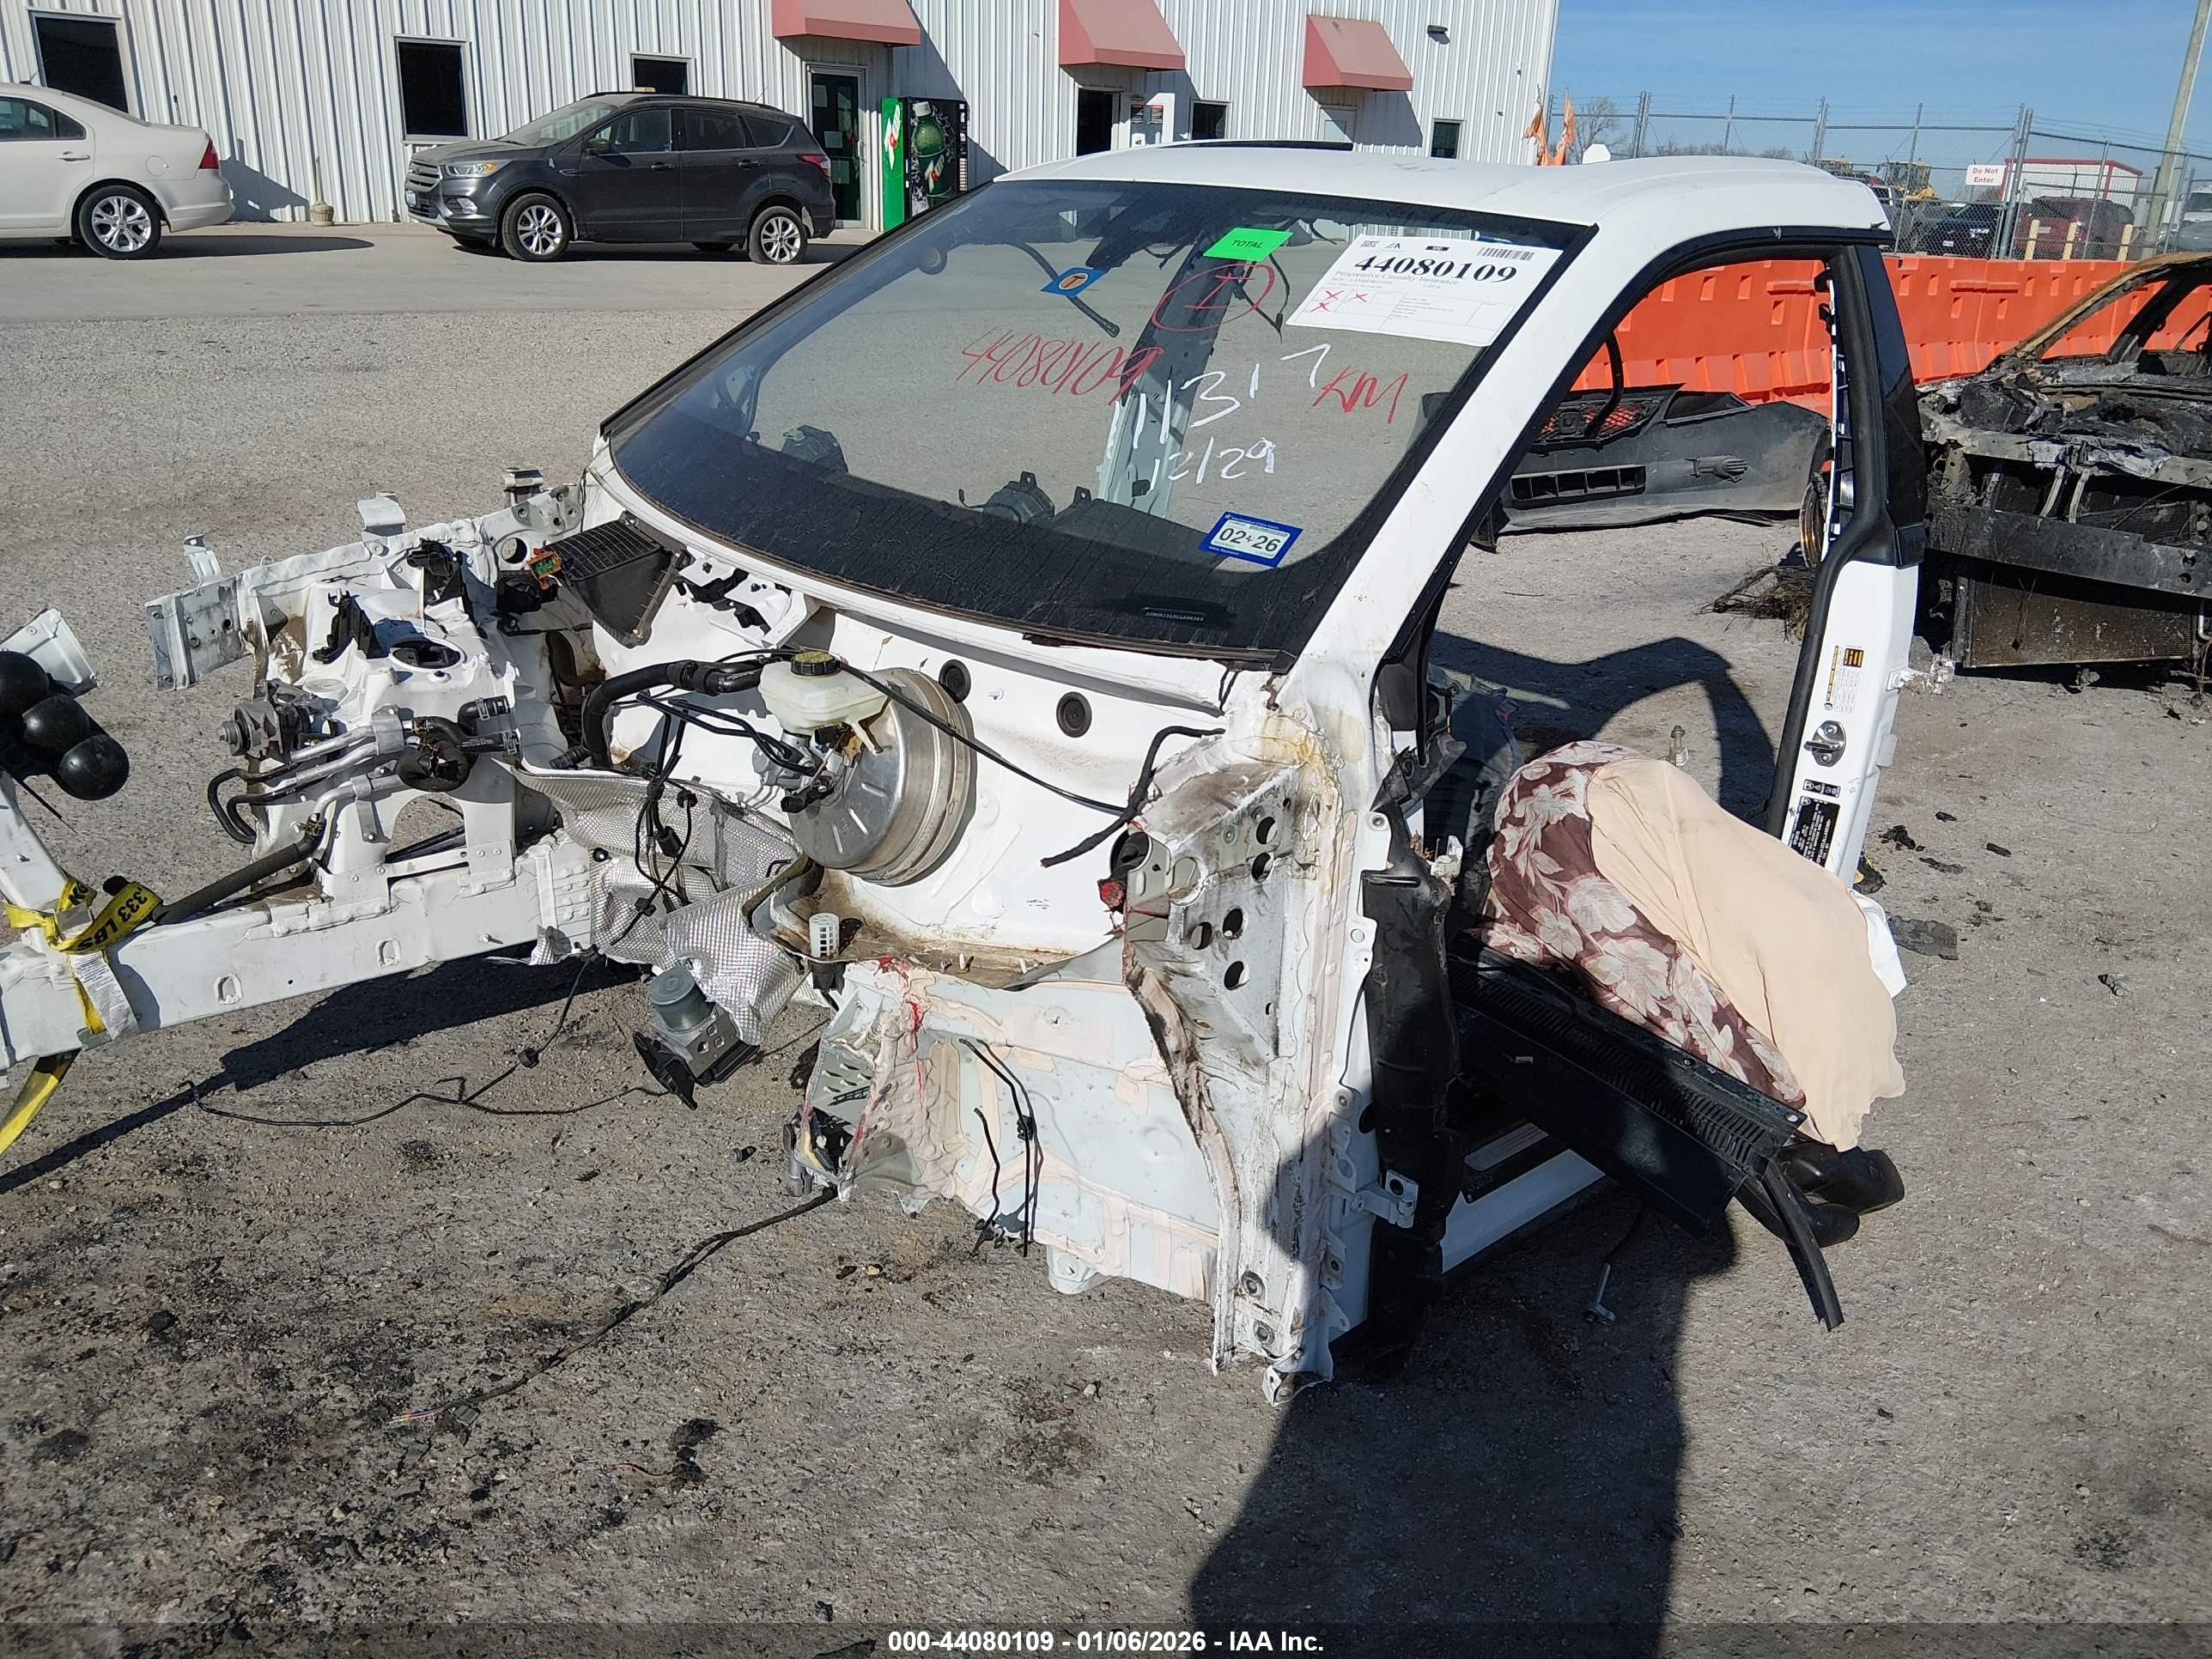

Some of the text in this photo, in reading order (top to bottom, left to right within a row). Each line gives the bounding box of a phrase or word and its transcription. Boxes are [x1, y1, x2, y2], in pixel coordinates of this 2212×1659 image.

[1231, 240, 1264, 249] TOTAL
[1334, 270, 1382, 280] Progressive
[1382, 273, 1417, 283] Casualty
[1419, 276, 1459, 285] Insurance
[1354, 254, 1517, 283] 44080109
[1218, 527, 1247, 544] 02
[1251, 535, 1281, 552] 26
[78, 918, 118, 950] LBS
